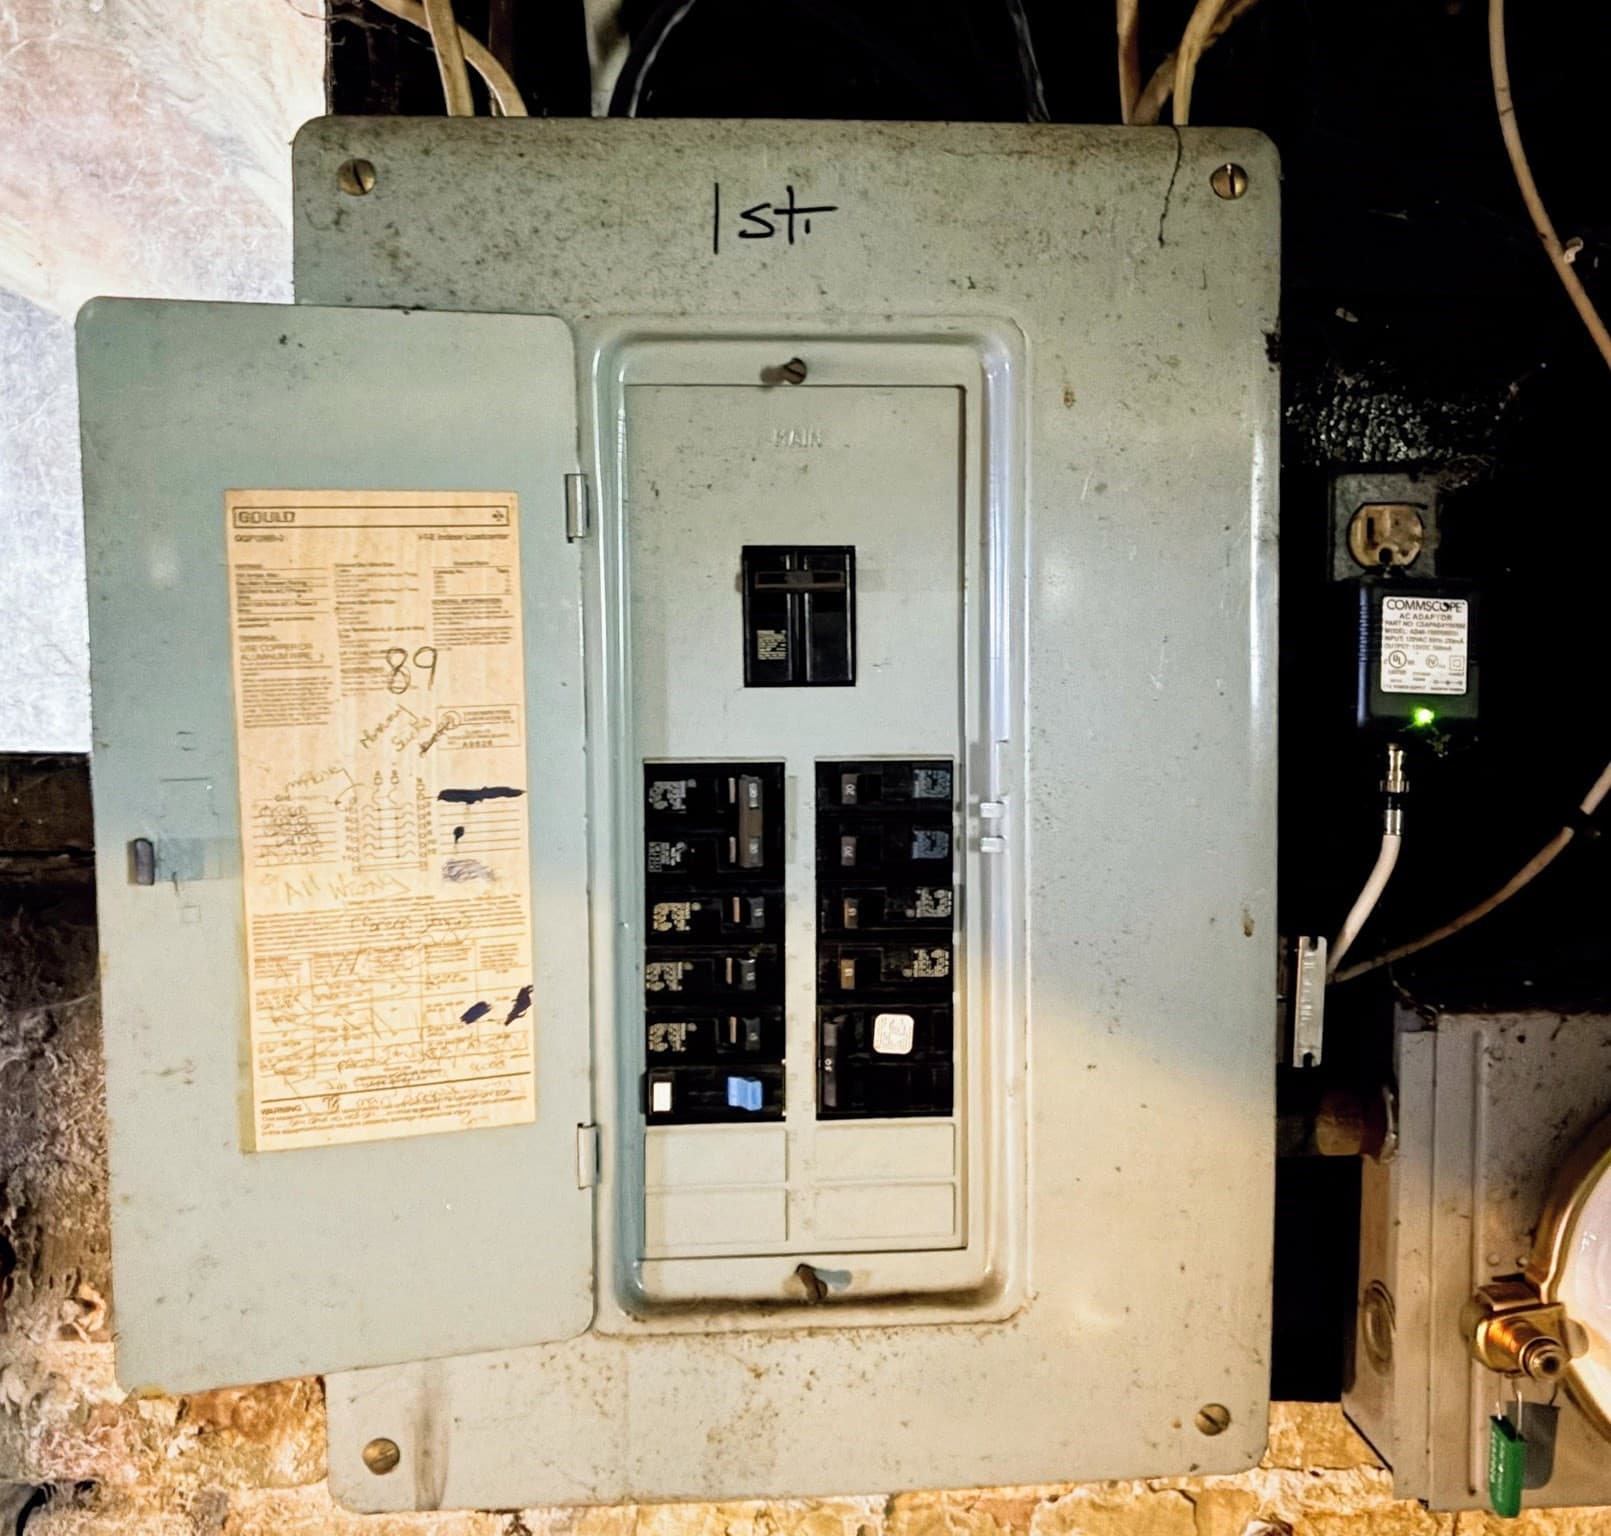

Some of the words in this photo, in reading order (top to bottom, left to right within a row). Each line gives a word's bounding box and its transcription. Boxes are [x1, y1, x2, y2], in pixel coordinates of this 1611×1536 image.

[237, 510, 296, 524] GOULD
[1399, 612, 1411, 620] AC
[385, 646, 438, 695] 89
[845, 783, 856, 796] 20
